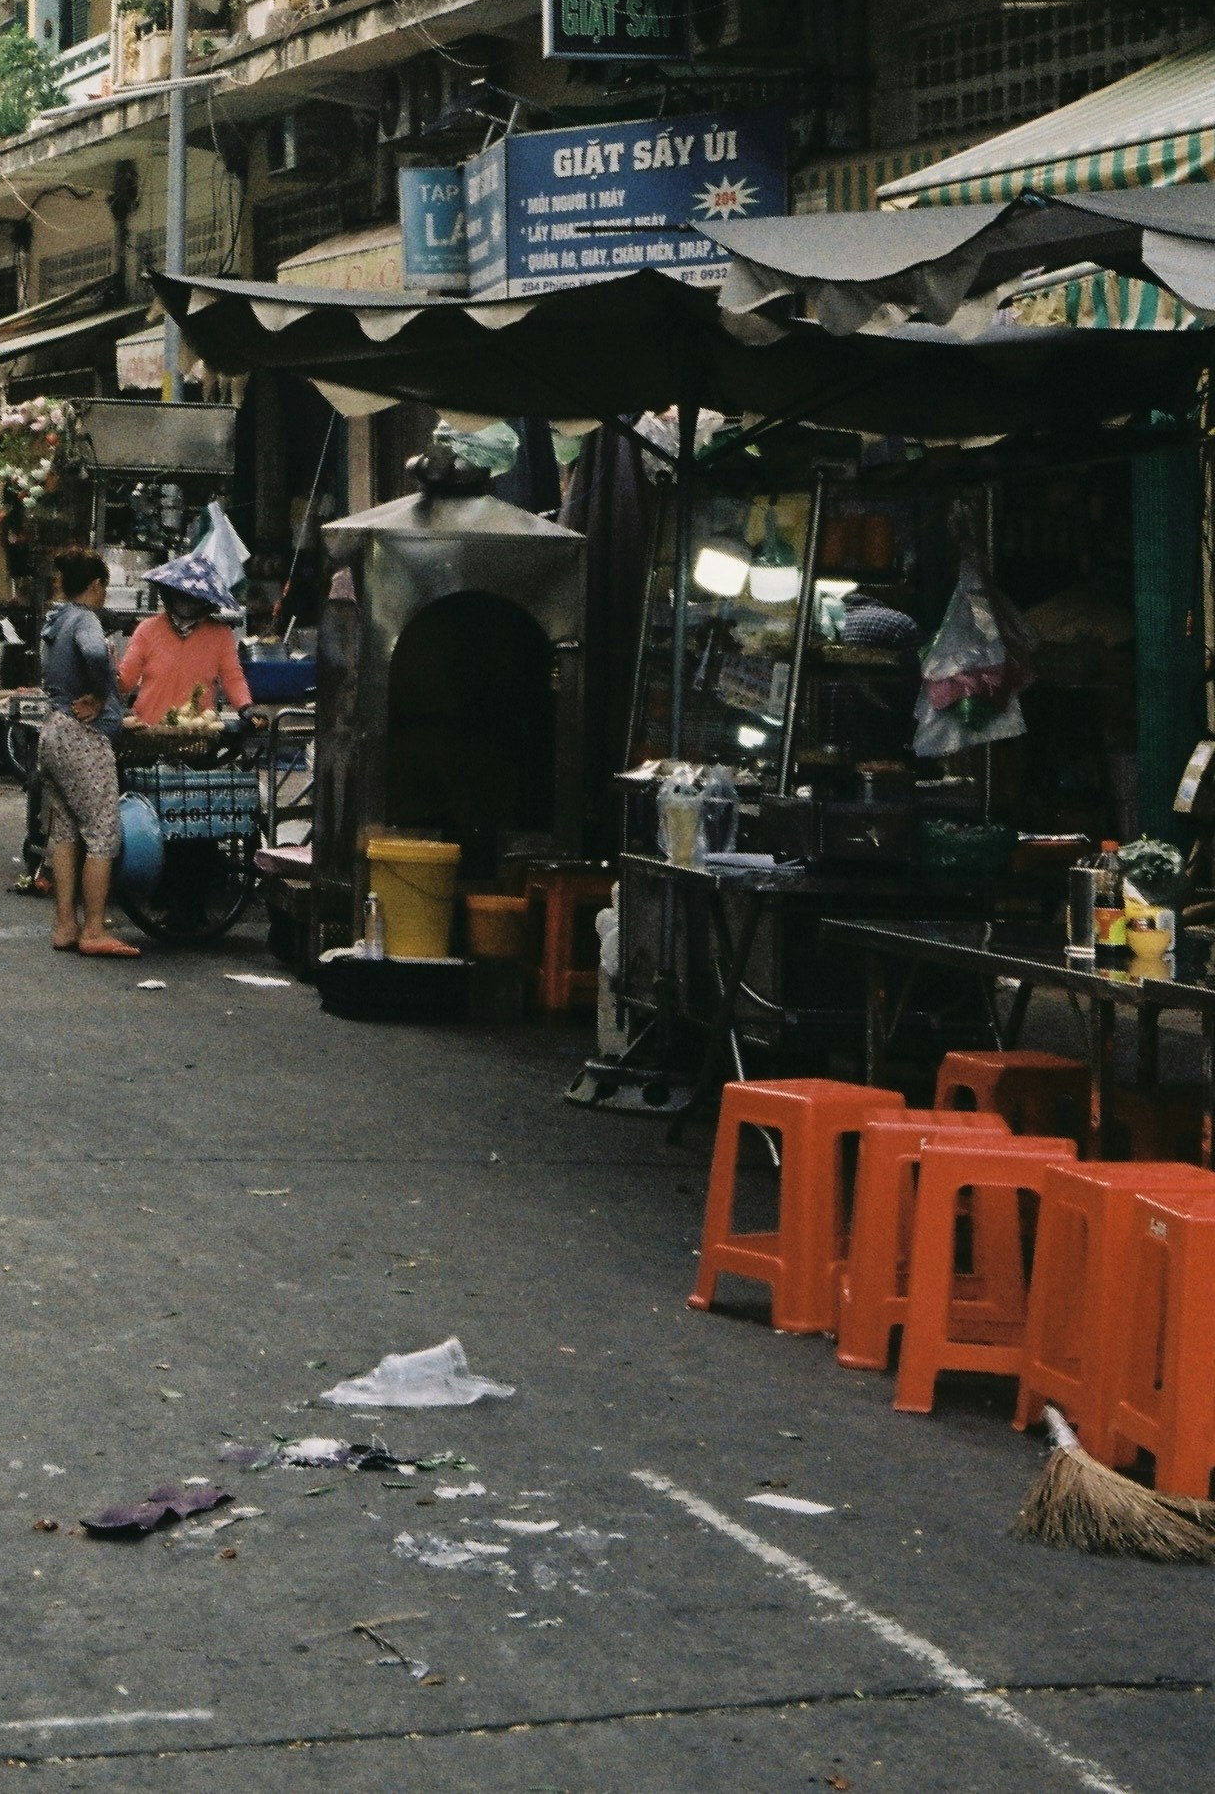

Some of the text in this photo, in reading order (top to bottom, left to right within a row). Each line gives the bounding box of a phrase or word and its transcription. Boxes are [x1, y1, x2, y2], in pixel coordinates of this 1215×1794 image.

[553, 124, 738, 180] GIẶT SẤY ỦI
[590, 192, 596, 209] 1
[599, 187, 626, 208] MÁY
[715, 192, 737, 207] 204
[521, 282, 540, 293] 204
